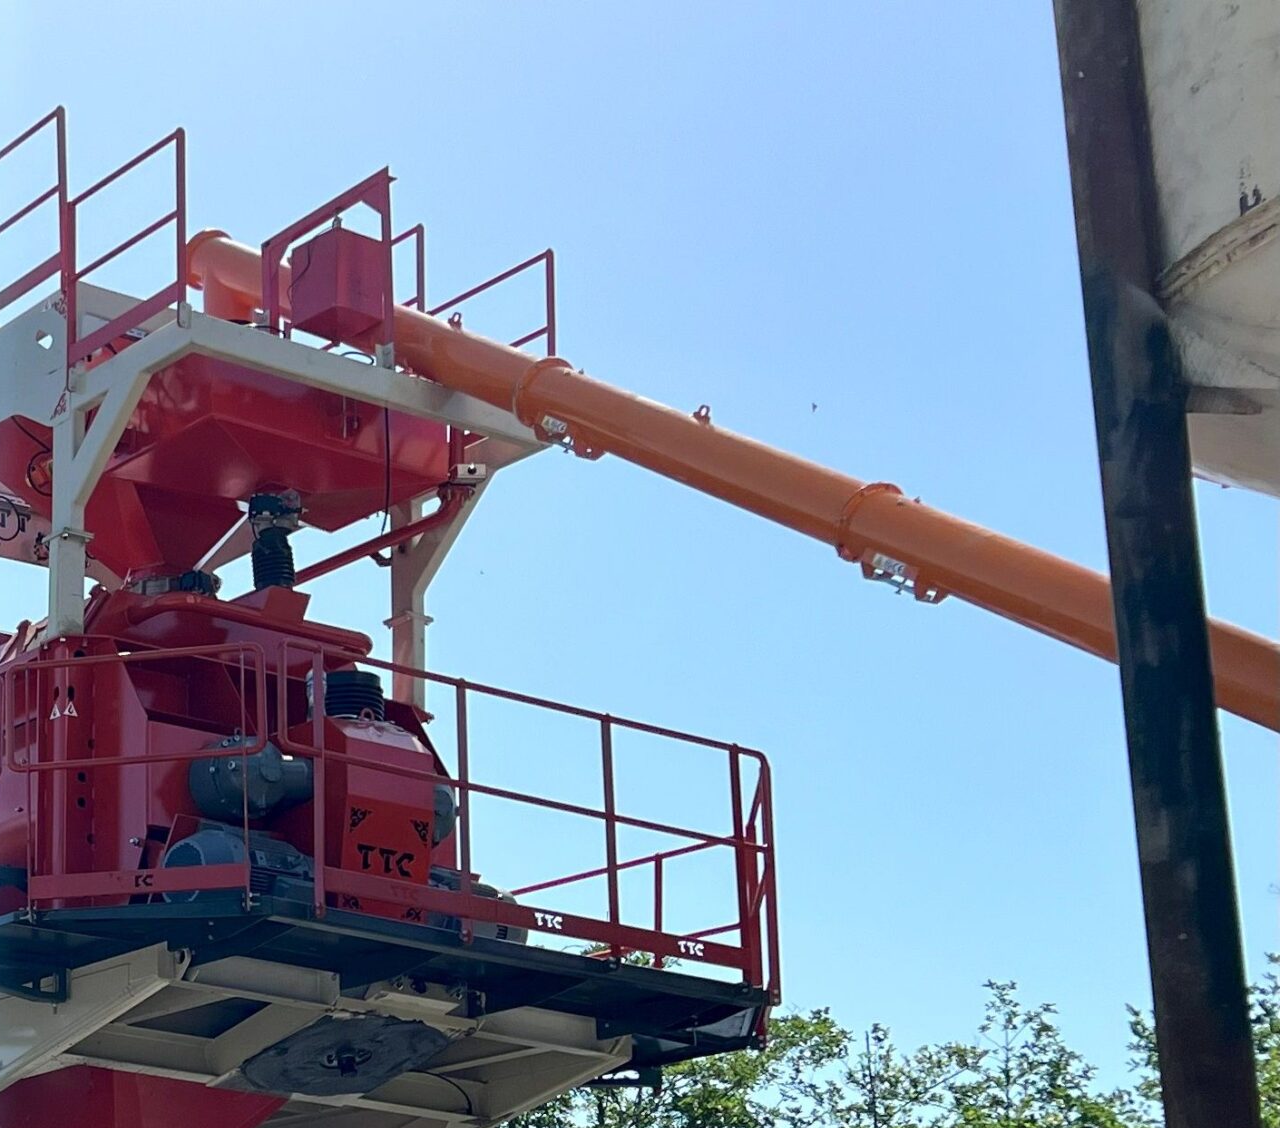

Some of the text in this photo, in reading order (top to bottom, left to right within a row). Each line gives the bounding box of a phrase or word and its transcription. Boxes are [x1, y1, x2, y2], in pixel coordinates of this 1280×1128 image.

[357, 843, 415, 877] TTC
[534, 912, 563, 930] TTC
[677, 940, 705, 957] TTC
